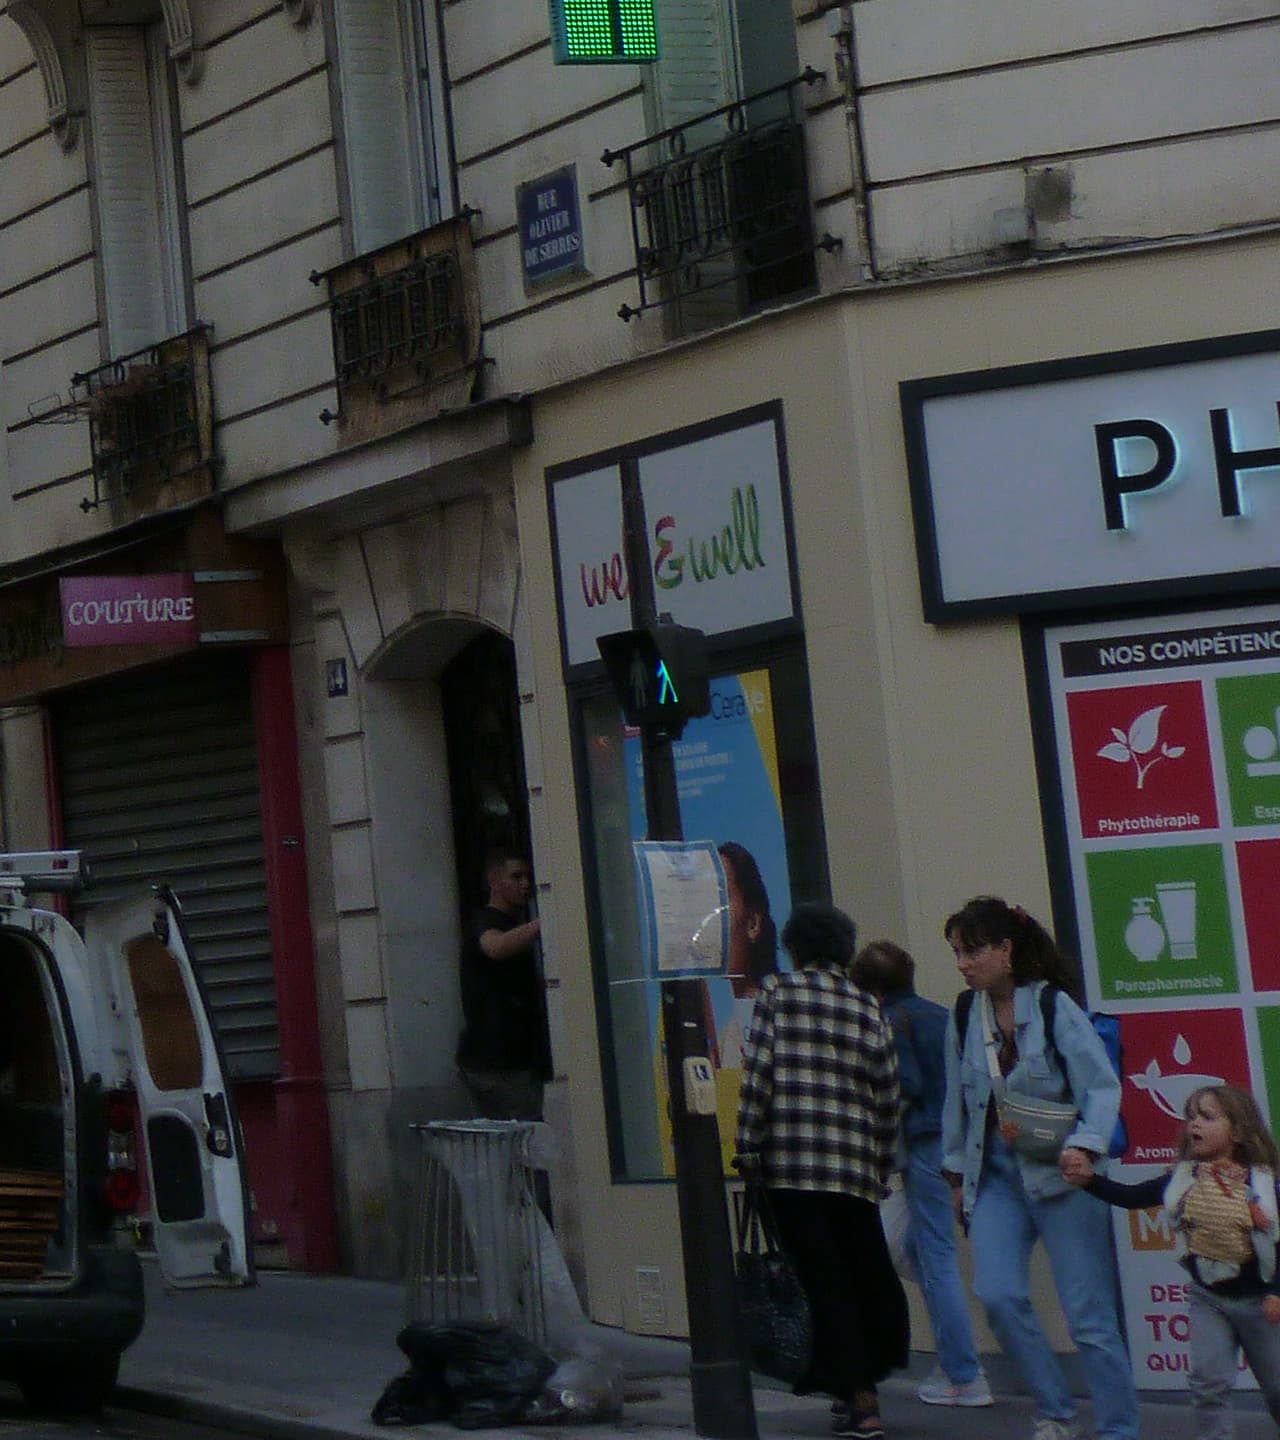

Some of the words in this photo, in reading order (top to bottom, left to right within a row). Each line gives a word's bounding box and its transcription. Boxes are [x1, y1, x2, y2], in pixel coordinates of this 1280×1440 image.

[537, 189, 558, 212] RUE
[529, 210, 570, 240] OLIVIER
[525, 247, 539, 267] DE
[539, 231, 581, 262] SERRES
[68, 591, 195, 626] COUTURE
[1100, 644, 1147, 667] NOS
[1098, 812, 1201, 833] Phytothérapie
[1114, 974, 1224, 994] Parapharmacie
[1134, 1146, 1179, 1159] Arom
[1143, 1314, 1192, 1342] TO
